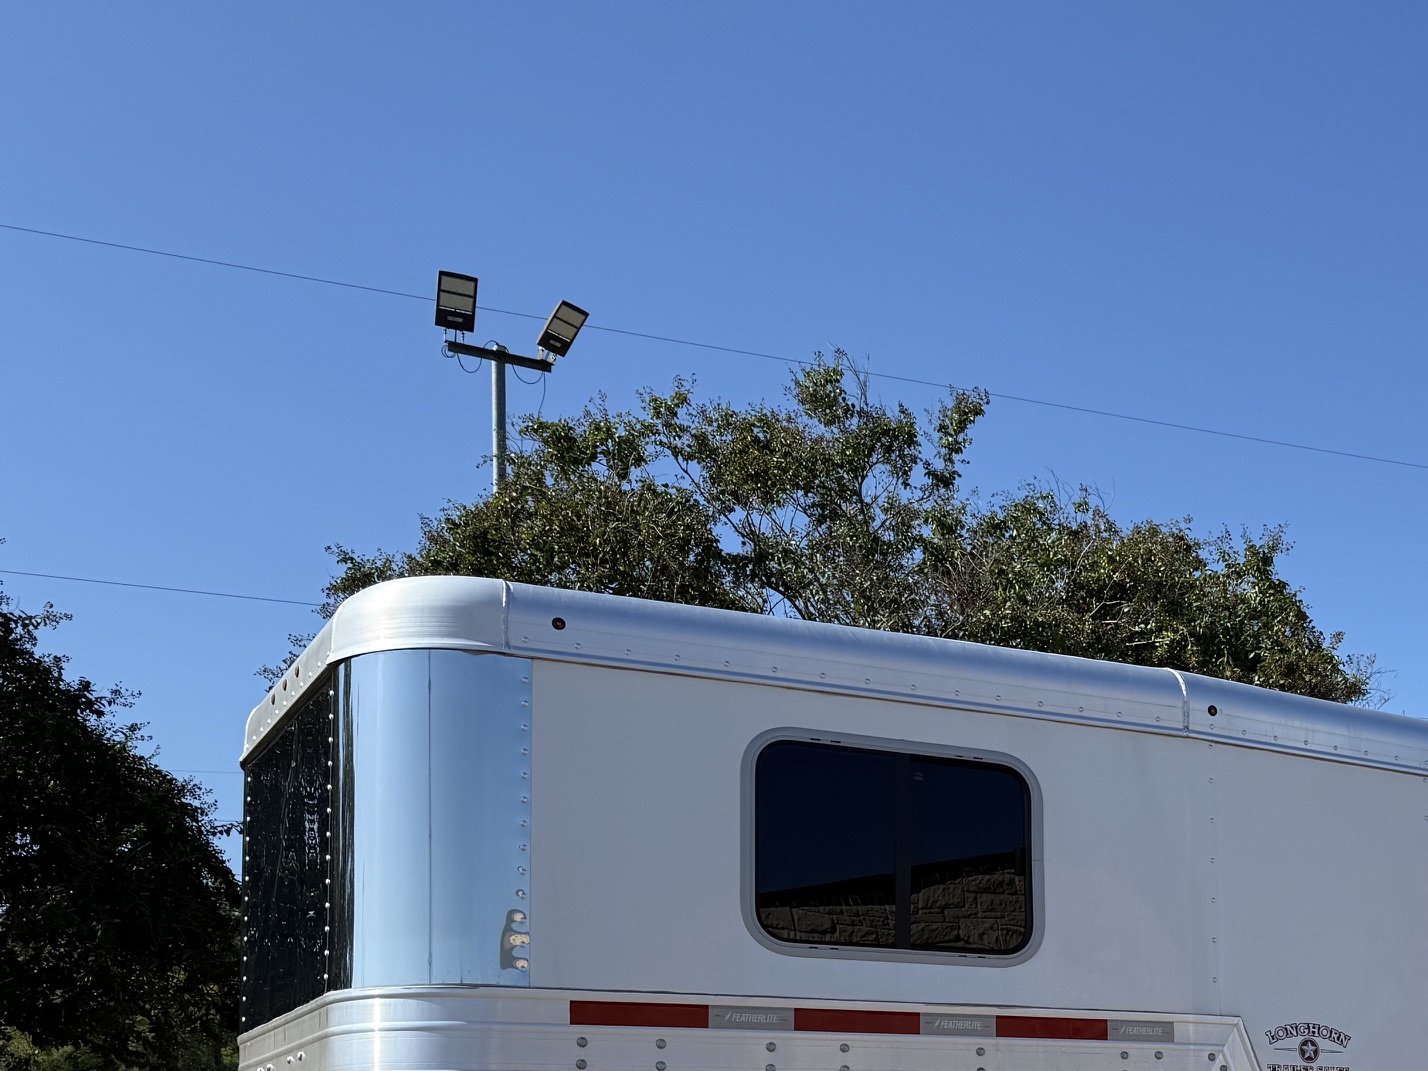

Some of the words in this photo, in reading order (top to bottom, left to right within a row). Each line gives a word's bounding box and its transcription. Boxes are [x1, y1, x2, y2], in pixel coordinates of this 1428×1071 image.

[732, 1013, 779, 1023] FEATHERLITE
[941, 1020, 982, 1030] FEATHERLITE
[1125, 1026, 1163, 1035] FEATHERLITE
[1265, 1022, 1351, 1048] LONGHORN
